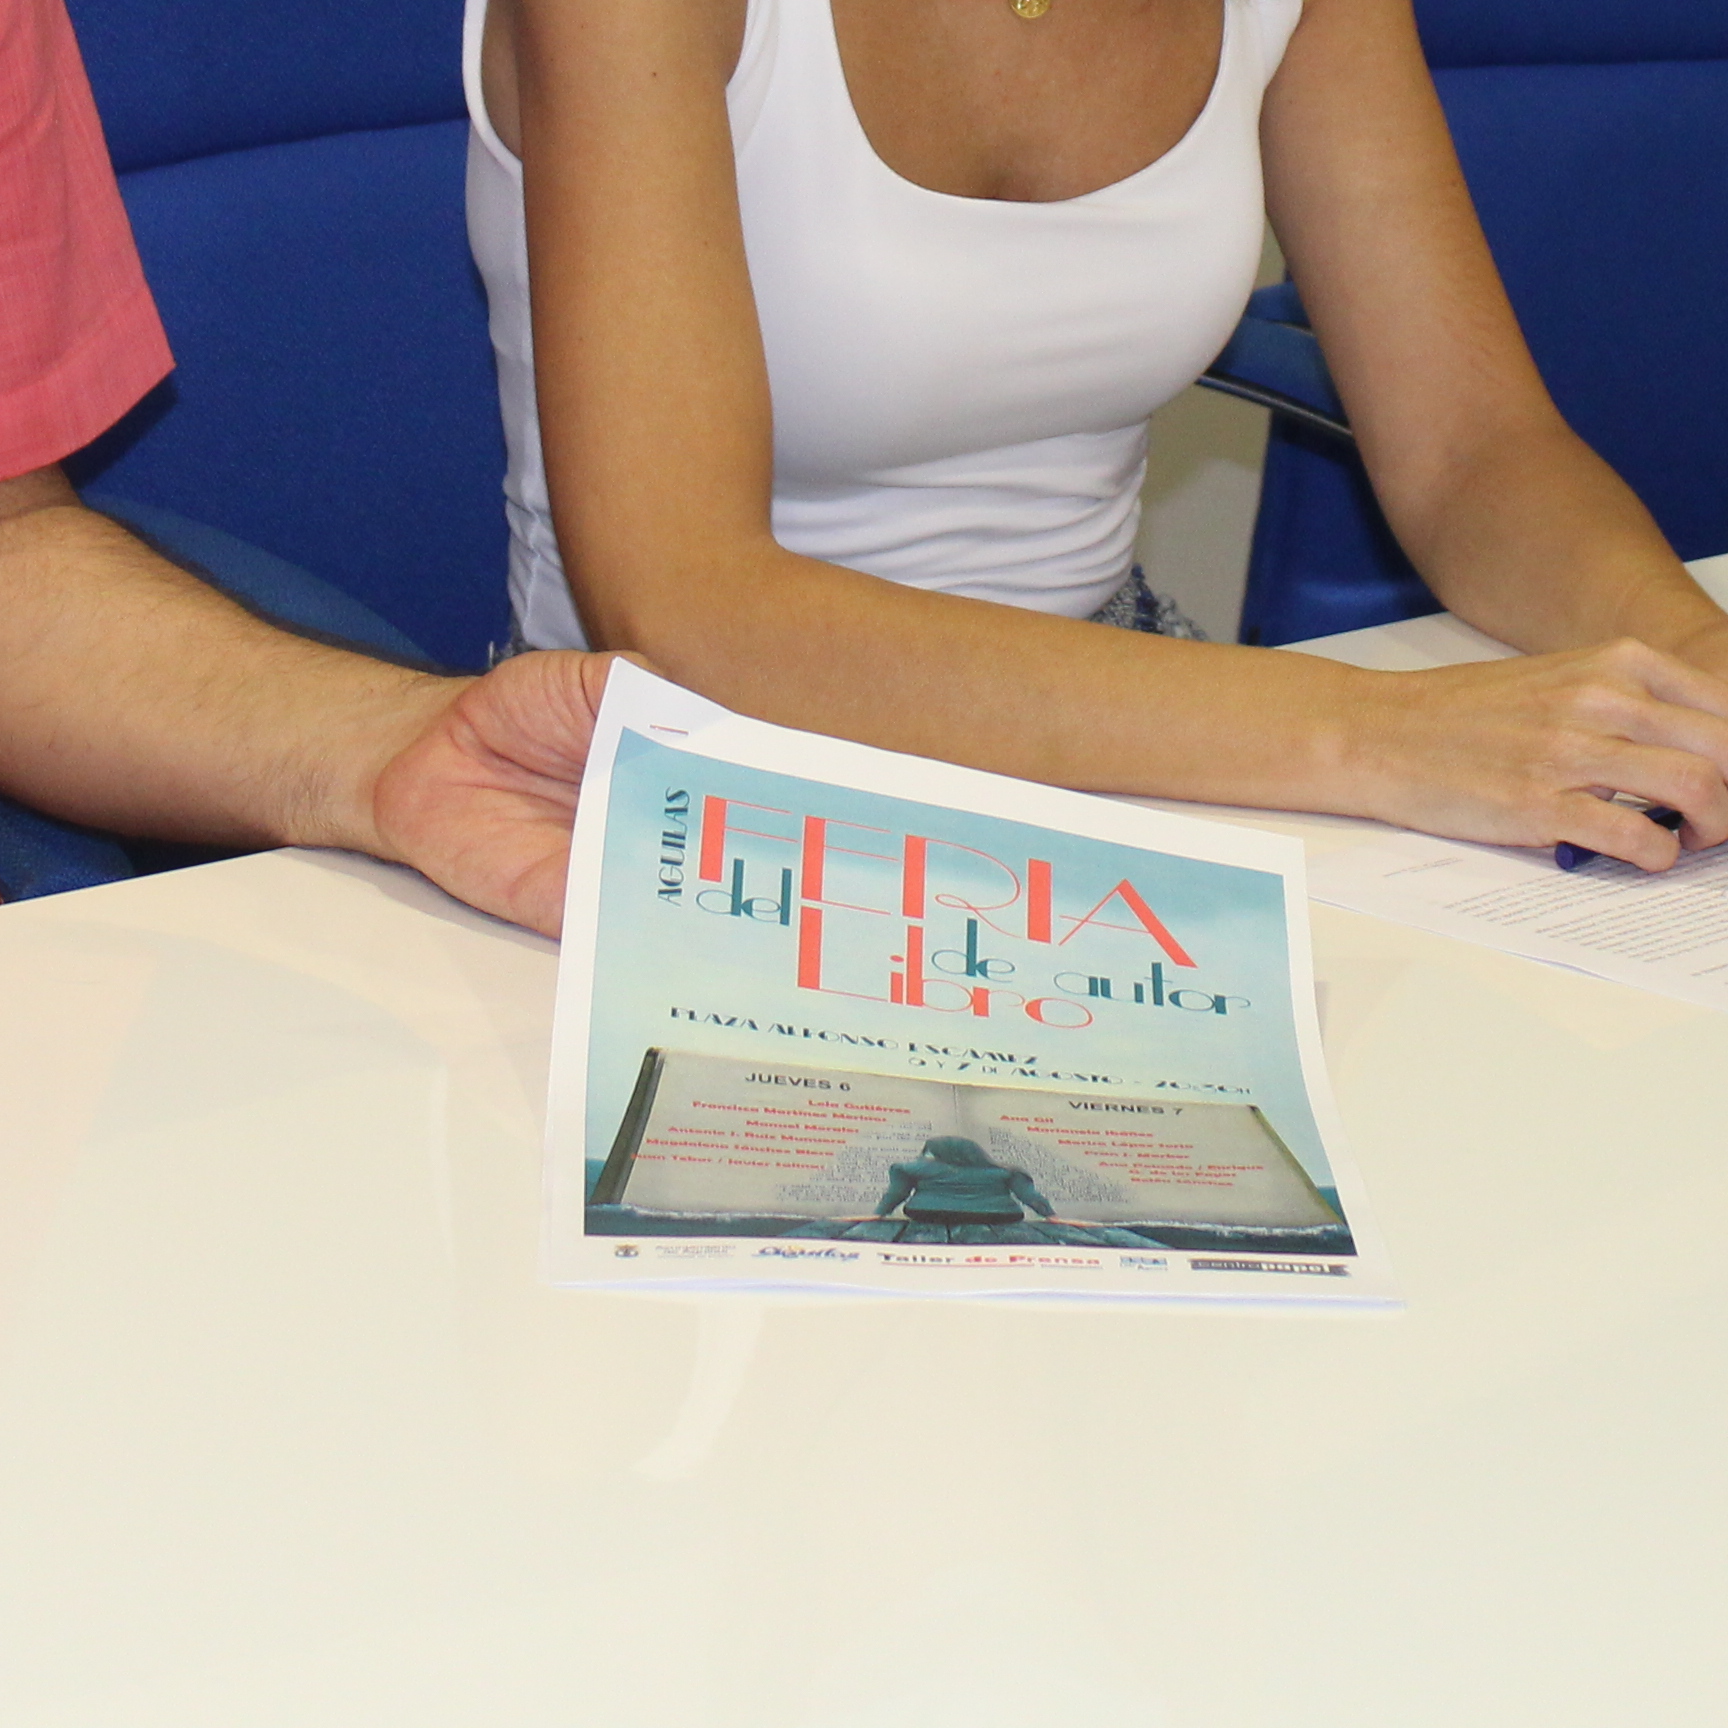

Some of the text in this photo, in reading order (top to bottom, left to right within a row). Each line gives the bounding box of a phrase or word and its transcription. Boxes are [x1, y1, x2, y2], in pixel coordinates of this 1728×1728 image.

[695, 857, 793, 927] del
[698, 793, 1200, 970] FERIA
[796, 904, 1094, 1029] Libro
[930, 917, 1252, 1016] de autor
[669, 1005, 760, 1032] PLAZA
[767, 1022, 900, 1050] ALFONSO
[744, 1072, 852, 1093] JUEVES 6
[1067, 1100, 1184, 1116] VIERNES 7
[877, 1251, 1101, 1265] Taller de Prensa
